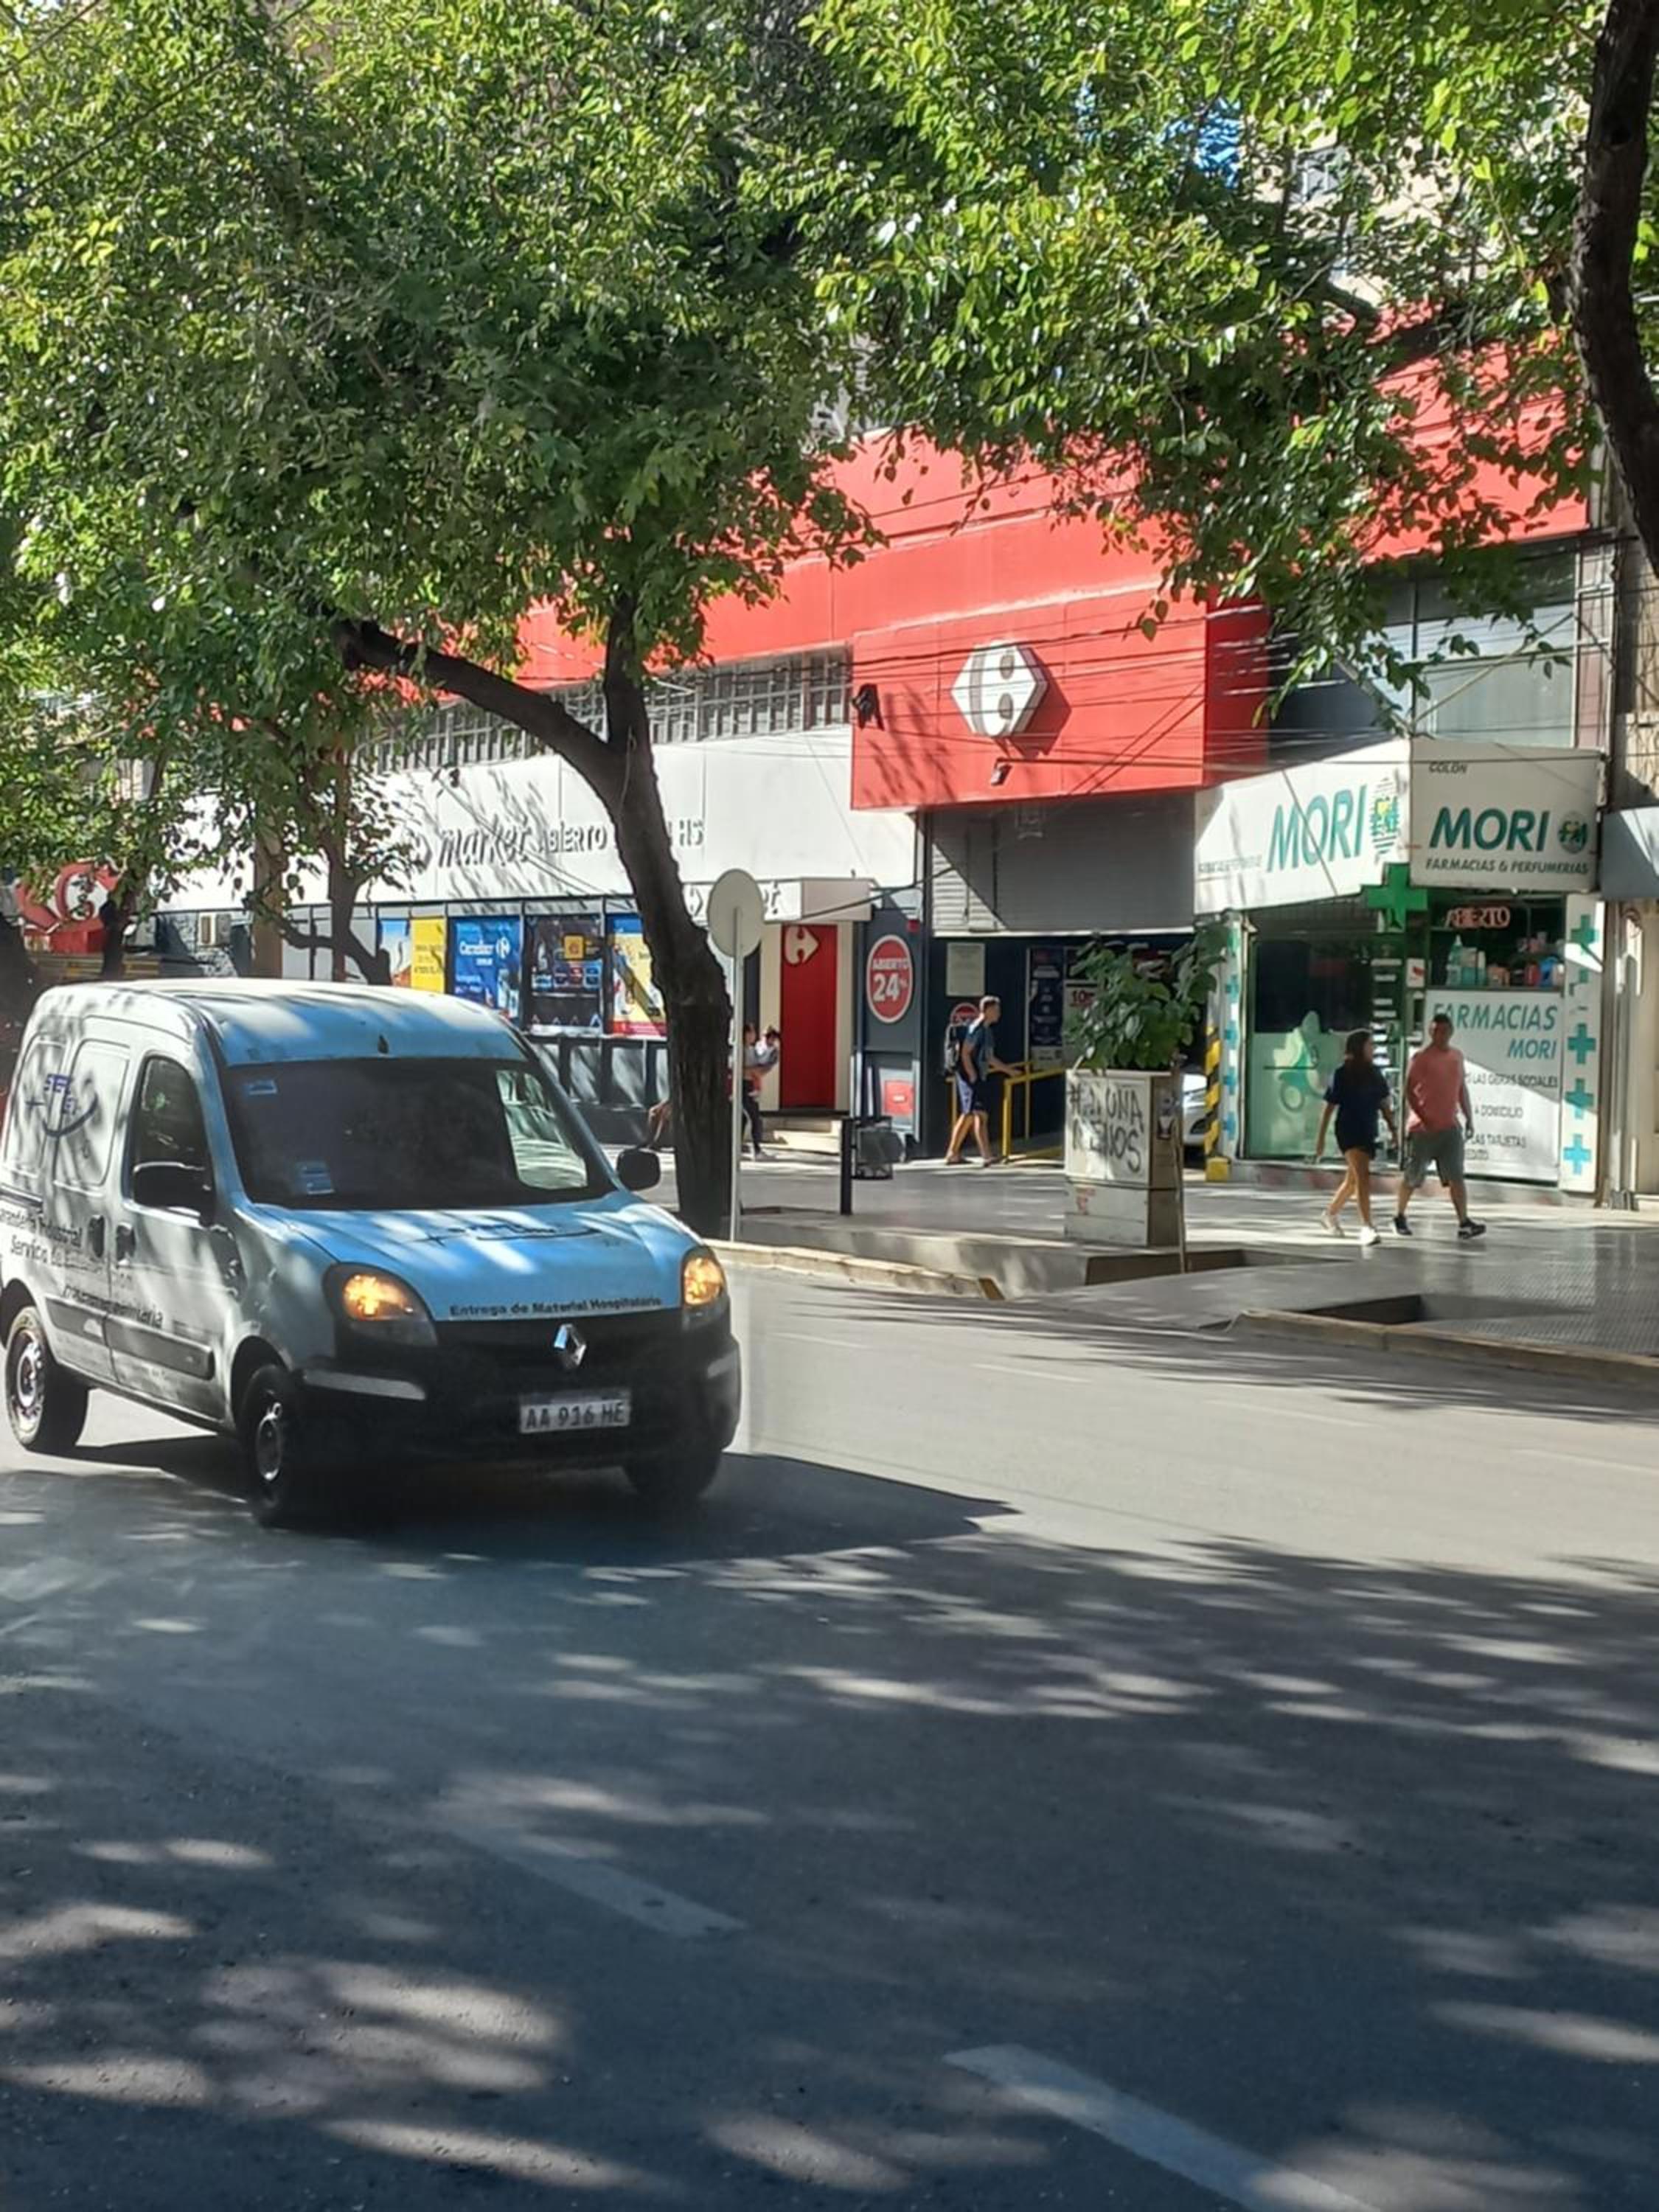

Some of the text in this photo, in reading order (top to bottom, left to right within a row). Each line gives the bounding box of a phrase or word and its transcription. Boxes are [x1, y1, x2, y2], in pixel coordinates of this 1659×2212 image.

[439, 814, 532, 869] market
[1266, 785, 1367, 872] MORI
[1429, 807, 1550, 852] MORI
[1426, 858, 1495, 872] FARMACIAS
[873, 973, 900, 1001] 24
[1433, 1003, 1558, 1031] FARMACIAS
[1507, 1038, 1557, 1060] MORI
[449, 1304, 507, 1316] Entrega
[511, 1302, 529, 1313] de
[532, 1300, 588, 1312] Material
[526, 1402, 625, 1430] AA 916 HE
